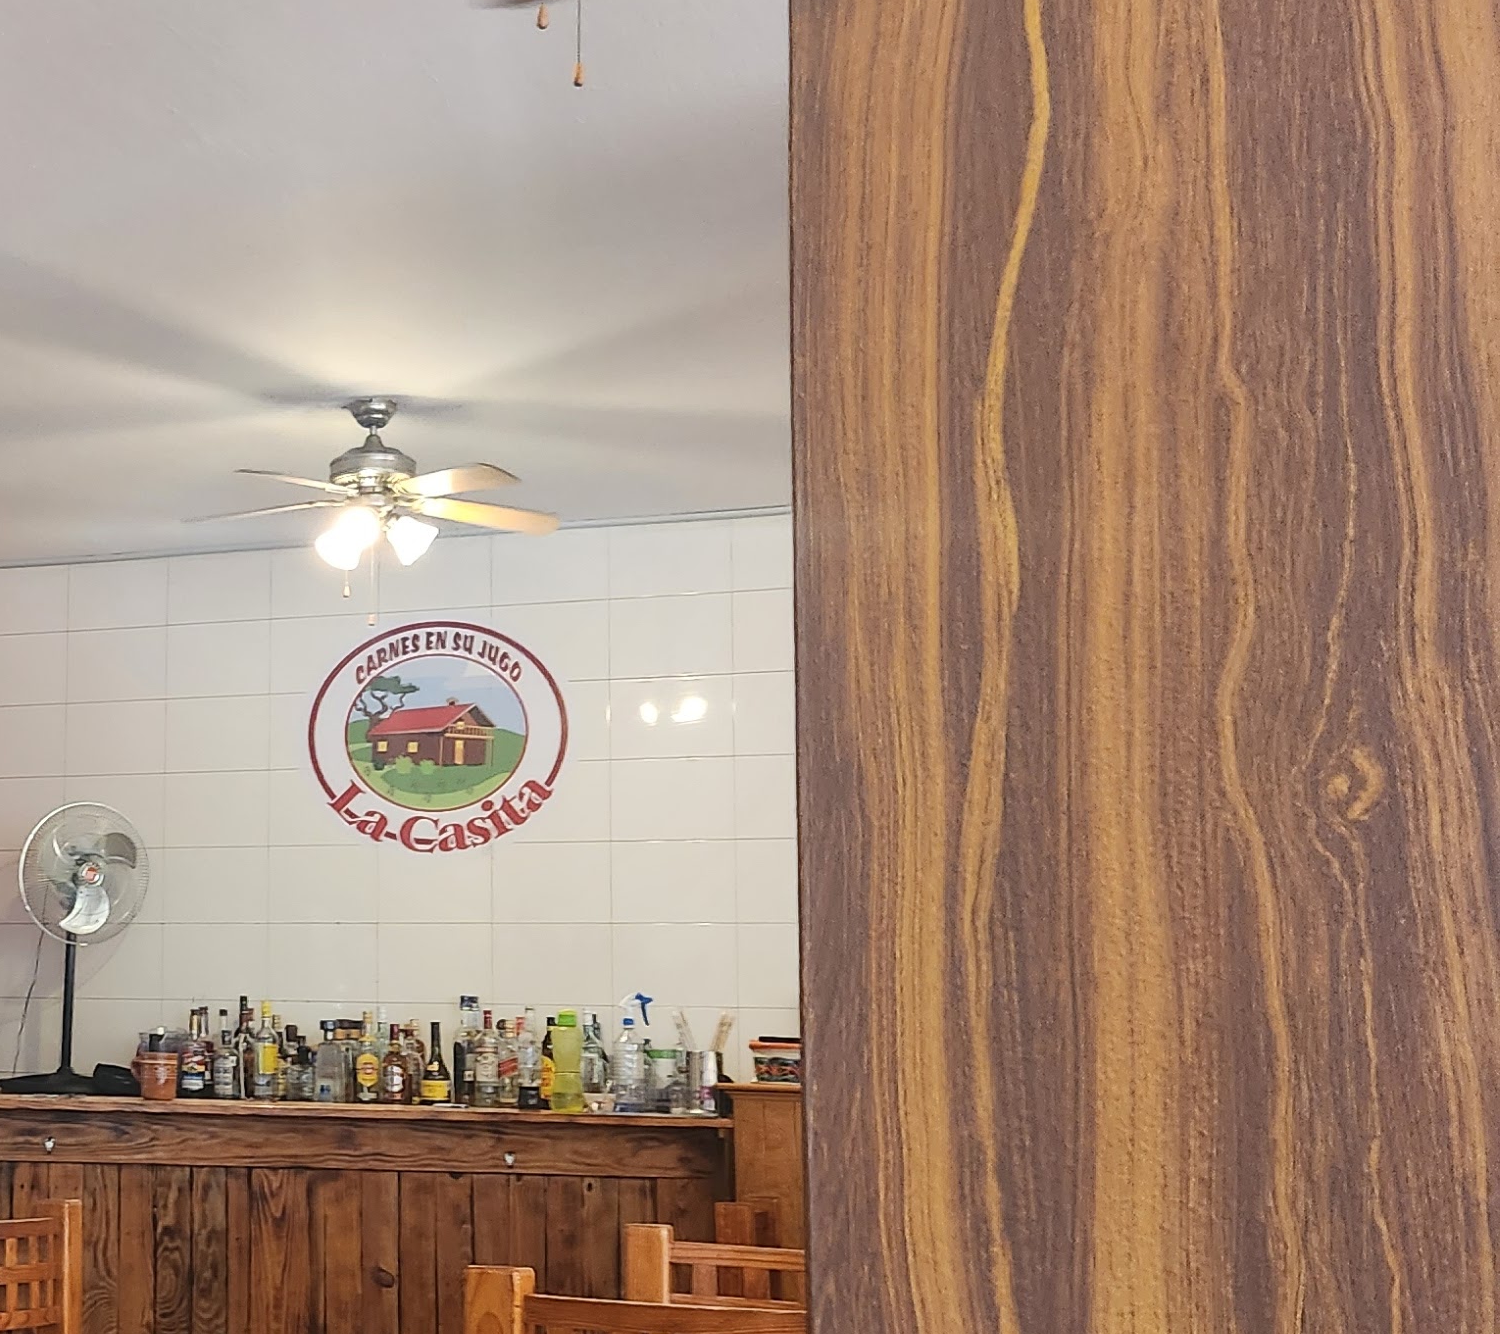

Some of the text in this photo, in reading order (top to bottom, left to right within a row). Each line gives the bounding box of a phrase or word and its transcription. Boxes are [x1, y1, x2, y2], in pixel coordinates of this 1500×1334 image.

[356, 630, 522, 684] CARNES EN SU JUGO
[326, 779, 554, 853] La Casita
